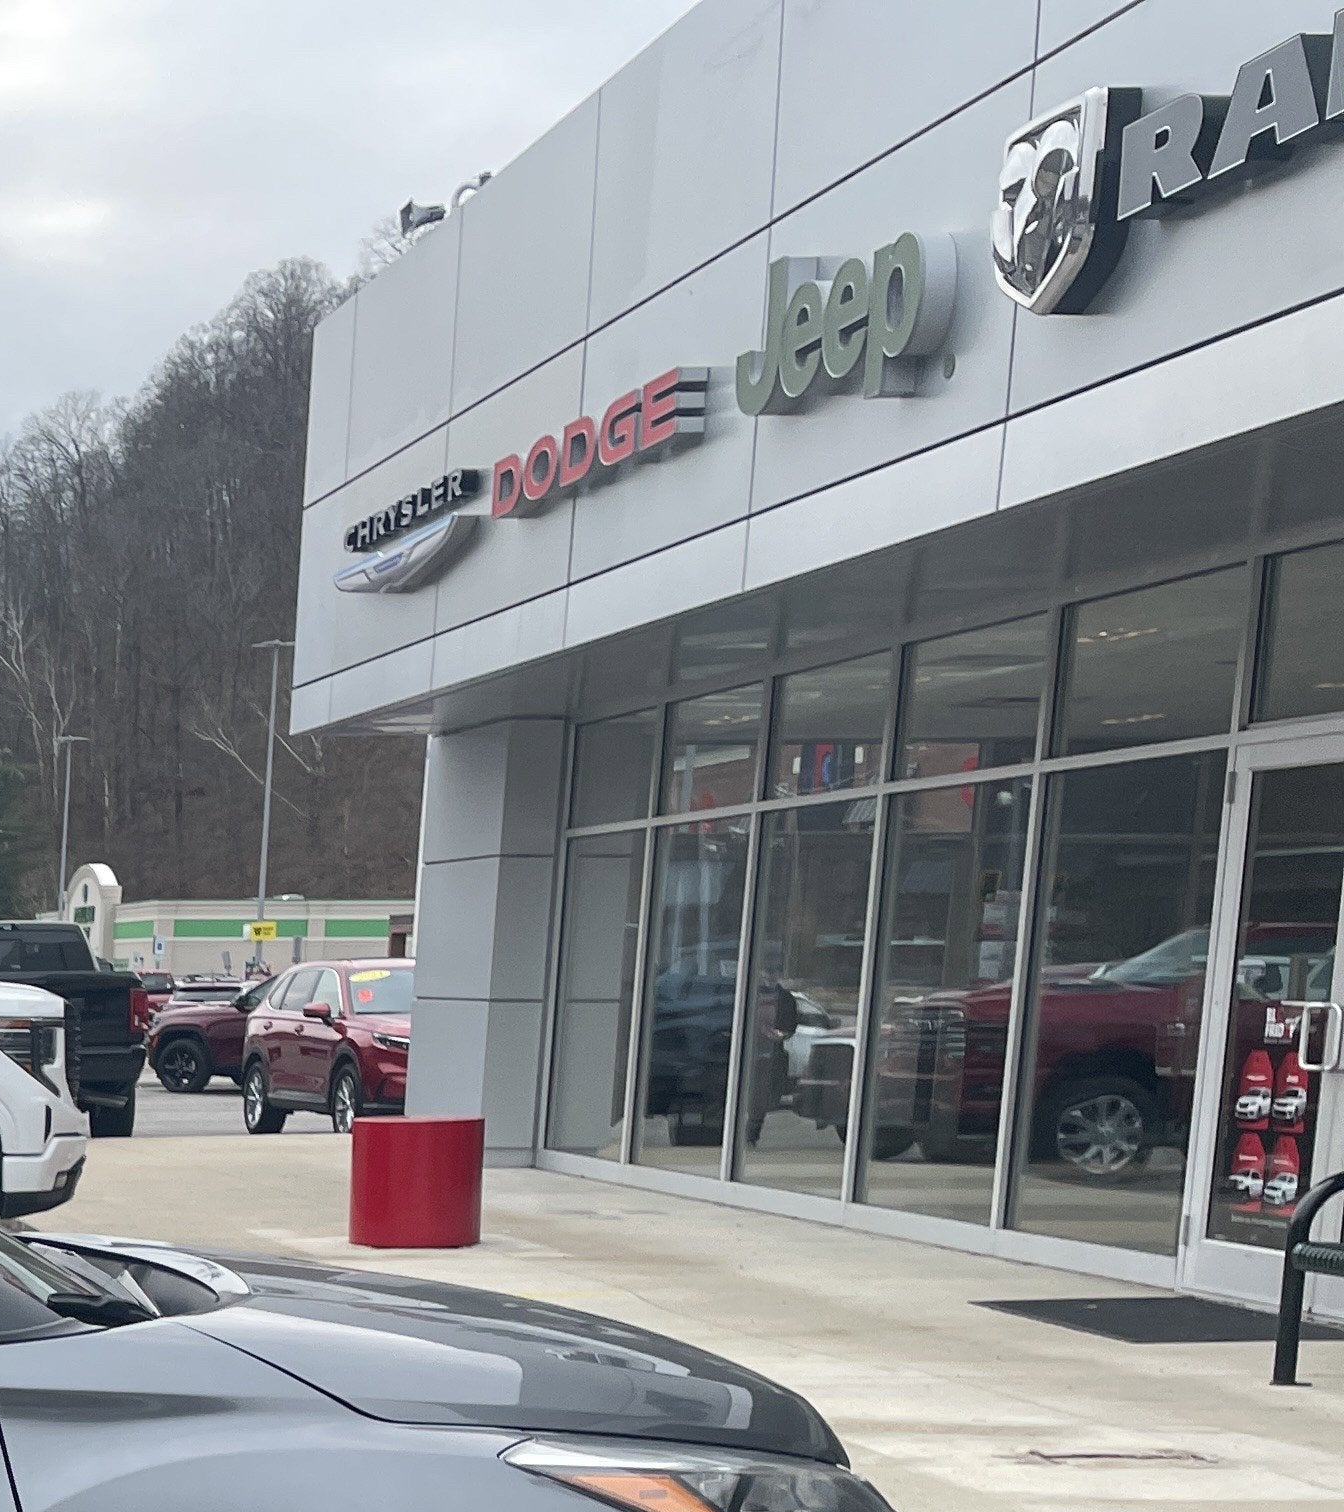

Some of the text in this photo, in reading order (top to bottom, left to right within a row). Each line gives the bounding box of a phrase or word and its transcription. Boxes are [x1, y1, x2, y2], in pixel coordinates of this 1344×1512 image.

[1117, 8, 1344, 221] RA
[736, 231, 926, 416] Jeep
[343, 468, 464, 553] CHRYSLER
[491, 366, 680, 520] DODGE
